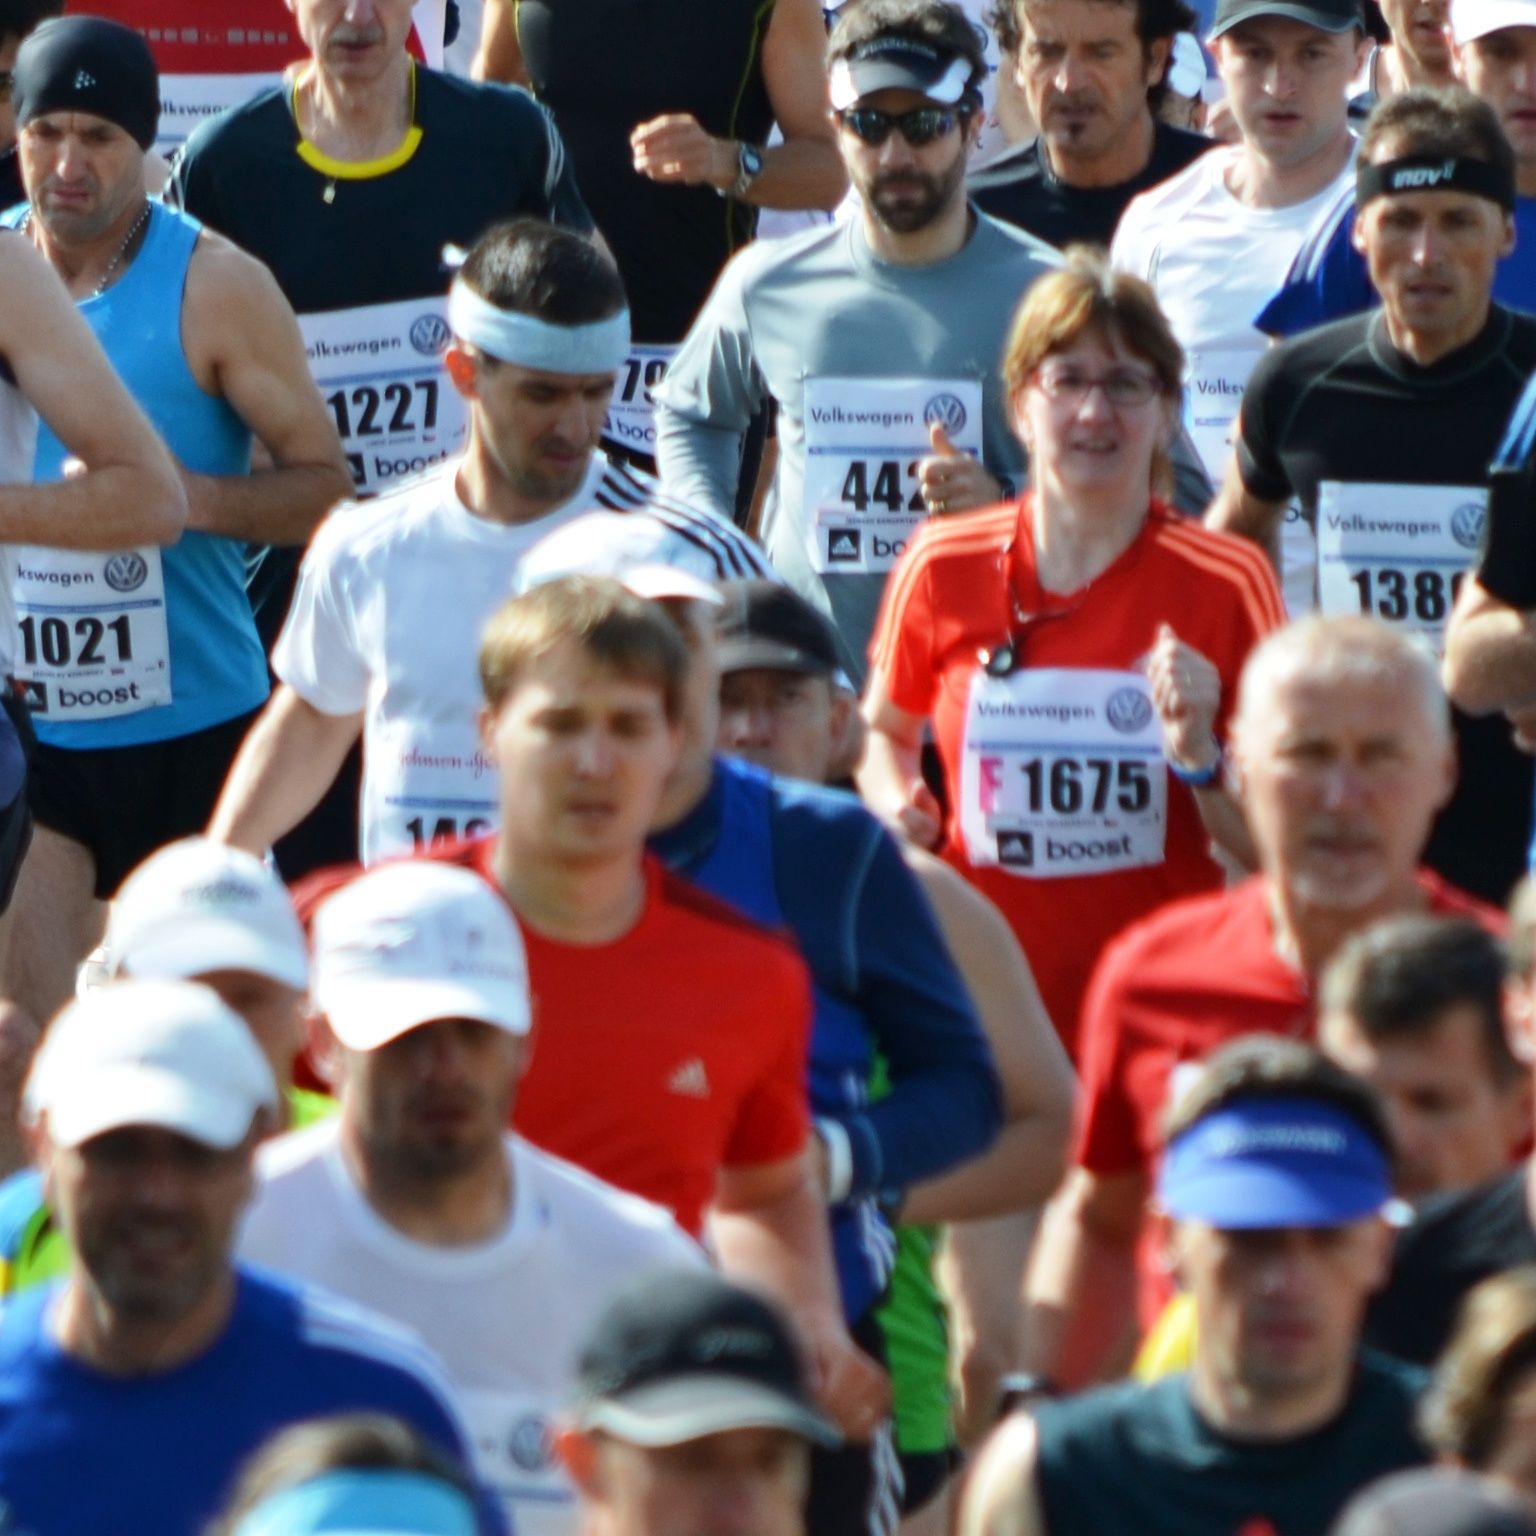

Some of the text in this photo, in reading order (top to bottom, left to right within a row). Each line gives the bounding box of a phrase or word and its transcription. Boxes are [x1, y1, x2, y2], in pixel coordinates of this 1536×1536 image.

[327, 379, 439, 440] 1227
[810, 406, 915, 429] Volkswagen
[1326, 512, 1442, 536] Volkswagen
[19, 617, 132, 665] 1021
[59, 683, 142, 707] boost
[976, 696, 1097, 721] Volkswagen
[1019, 757, 1152, 814] 1675
[1046, 832, 1133, 862] boost
